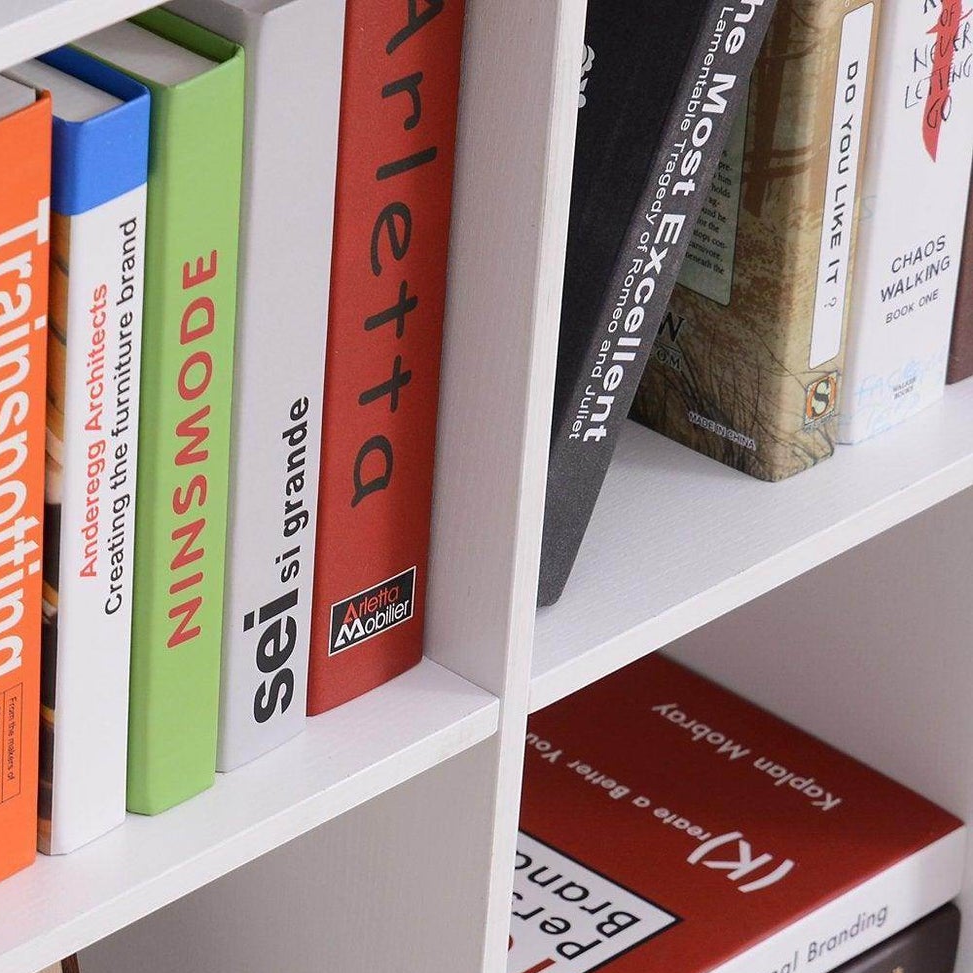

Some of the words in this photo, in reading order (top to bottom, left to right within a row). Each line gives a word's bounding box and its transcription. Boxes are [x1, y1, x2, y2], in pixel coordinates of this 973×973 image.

[680, 7, 734, 131] Lamentable
[845, 61, 858, 103] DO
[671, 73, 737, 197] Most
[927, 96, 952, 129] GO
[837, 114, 853, 175] YOU
[645, 139, 688, 225] Tragedy
[636, 232, 650, 253] of
[830, 184, 847, 250] LIKE
[116, 217, 137, 307] brand
[826, 259, 840, 284] IT
[880, 255, 950, 302] WALKING
[891, 235, 946, 274] CHAOS
[608, 258, 643, 333] Romeo
[886, 303, 915, 324] BOOK
[918, 288, 939, 307] ONE
[583, 213, 686, 442] Excellent
[85, 283, 108, 431] Architects
[112, 311, 133, 438] furniture
[591, 339, 611, 379] and
[569, 384, 596, 440] Juliet
[110, 442, 128, 490] the
[167, 249, 219, 650] NINSMODE
[282, 395, 309, 538] grande
[80, 439, 107, 578] Anderegg
[105, 493, 131, 616] Creating
[275, 545, 301, 583] si
[334, 599, 410, 647] Mobilier
[343, 585, 399, 625] Arletta
[243, 587, 299, 724] sei
[651, 703, 751, 760] Mobray
[567, 759, 630, 800] Better
[632, 796, 650, 808] a
[753, 756, 842, 812] Kaplan
[806, 904, 889, 963] Branding
